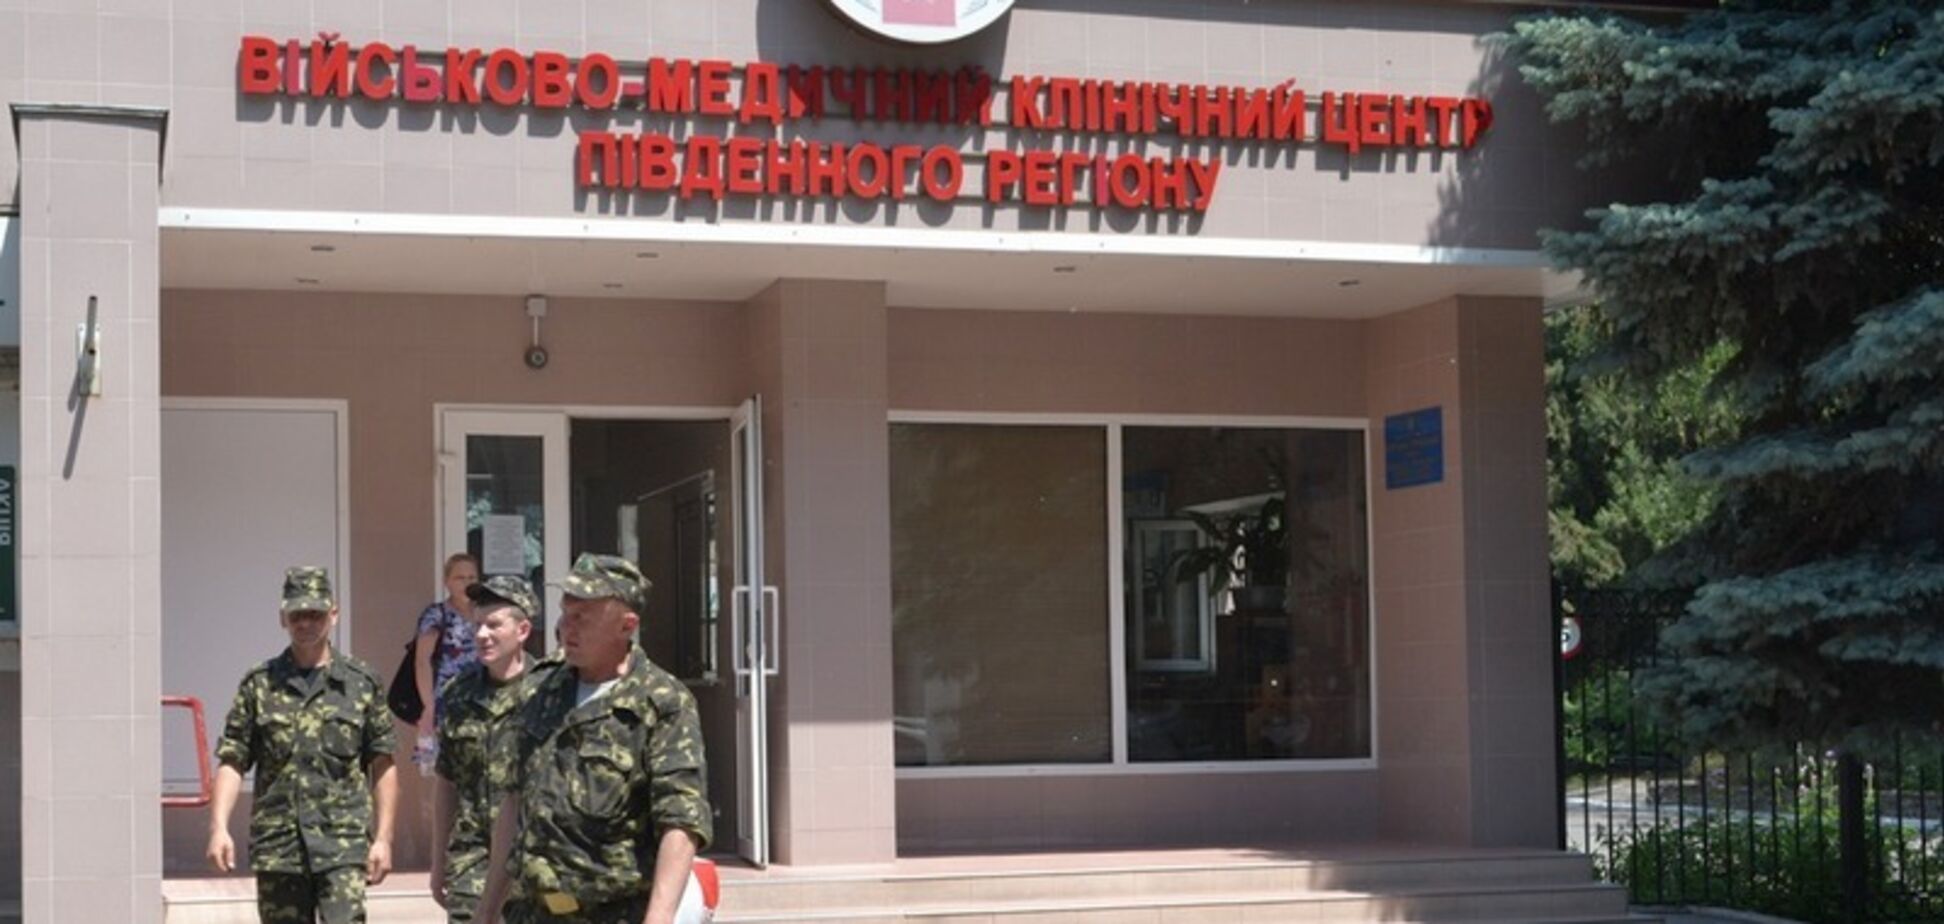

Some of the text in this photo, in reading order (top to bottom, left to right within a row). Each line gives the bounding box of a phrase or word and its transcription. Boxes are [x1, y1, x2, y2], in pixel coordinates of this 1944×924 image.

[239, 32, 1494, 153] ВІЙСЬКОВО-МЕДИЧНИЙ КЛІНІЧНИЙ ЦЕНТР
[577, 130, 1222, 212] ПІВДЕННОГО РЕГІОНУ
